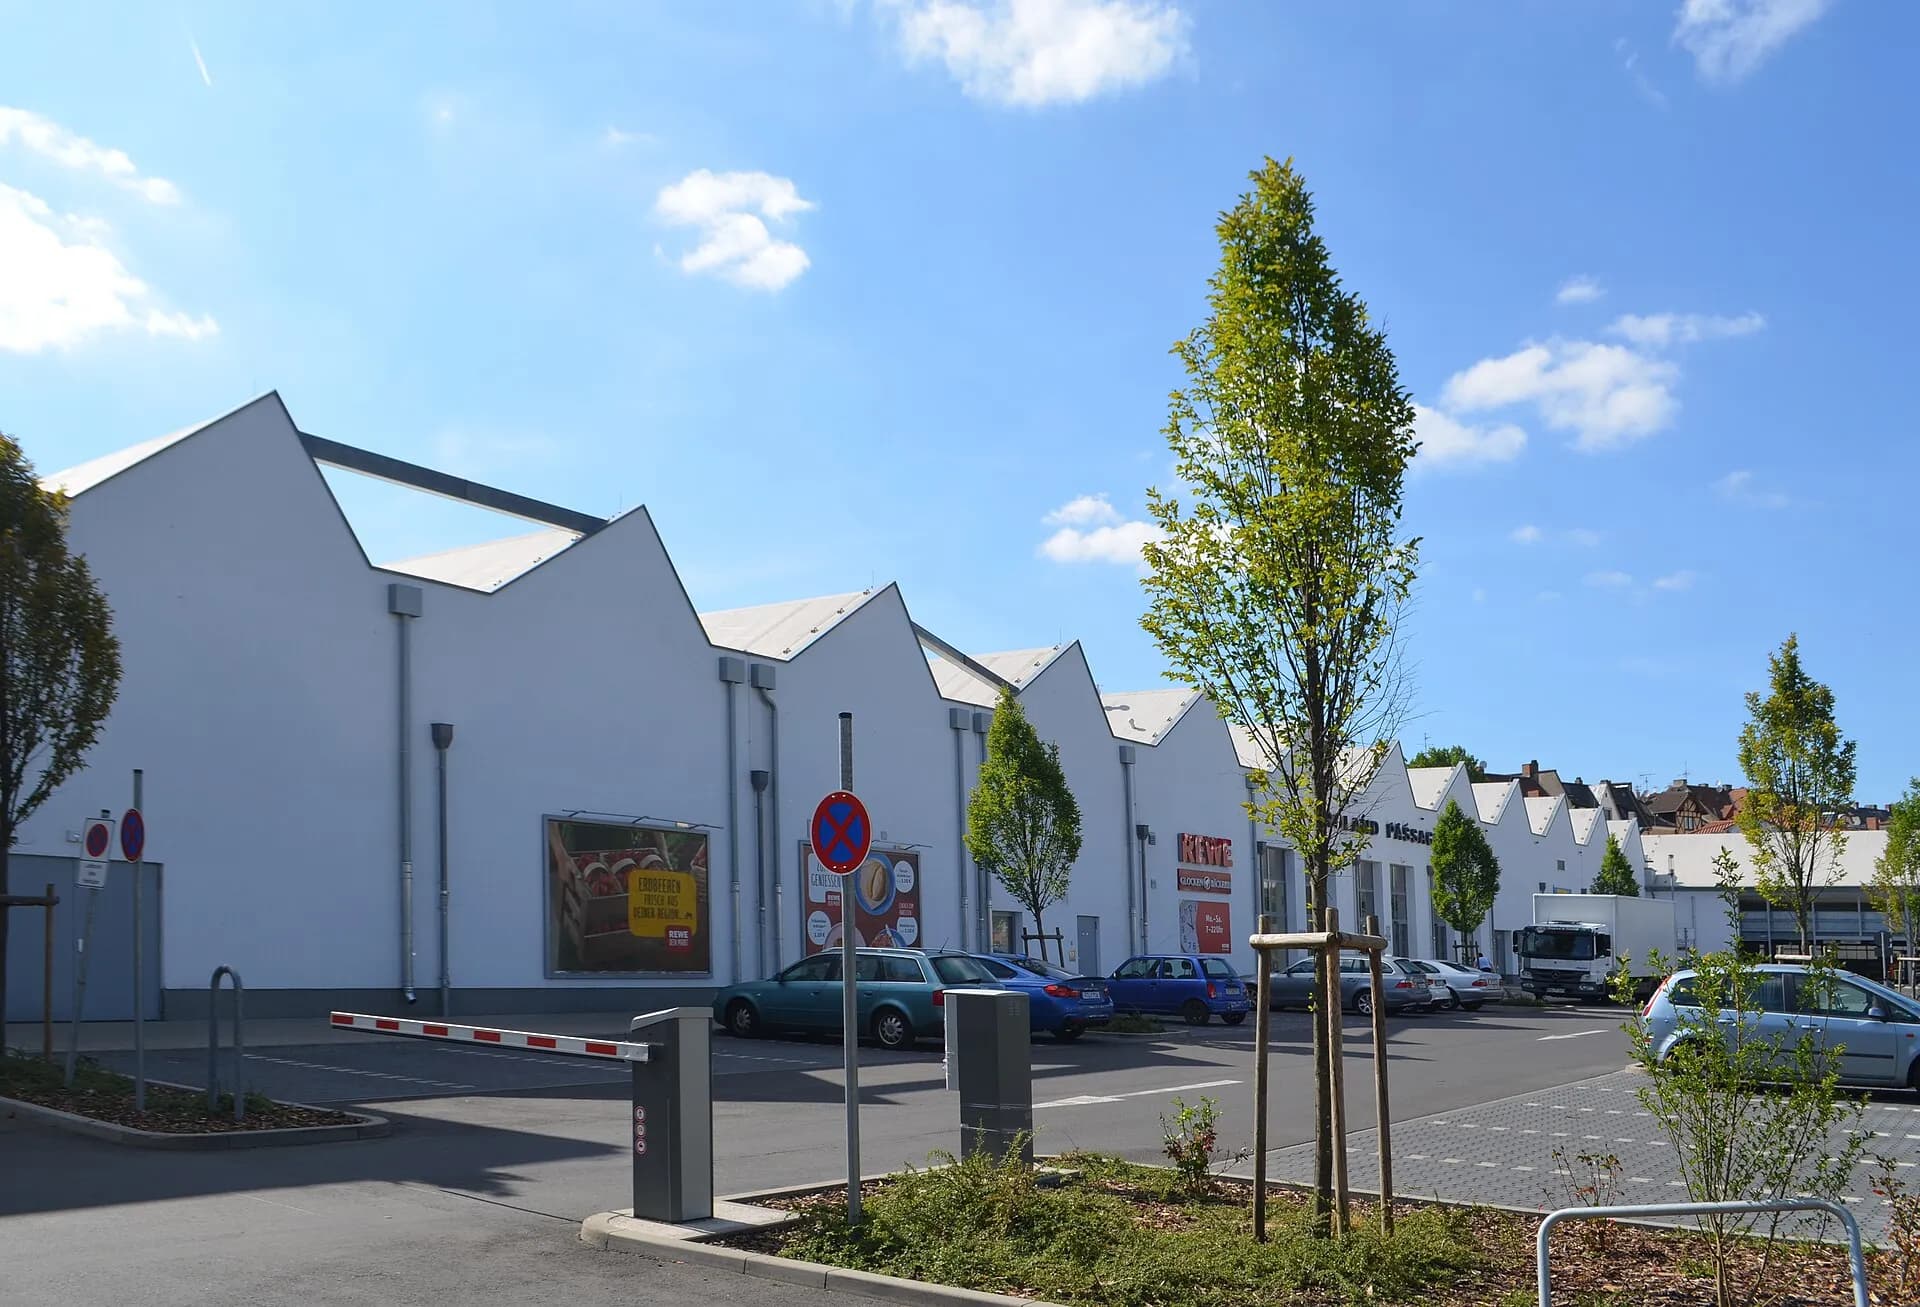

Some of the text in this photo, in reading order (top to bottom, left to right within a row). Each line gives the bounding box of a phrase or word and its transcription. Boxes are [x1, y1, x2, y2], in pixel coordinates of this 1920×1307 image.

[1385, 822, 1433, 845] PASSAG
[1178, 833, 1233, 867] REWE
[638, 877, 681, 894] ERDBEEREN
[668, 930, 689, 939] REWE
